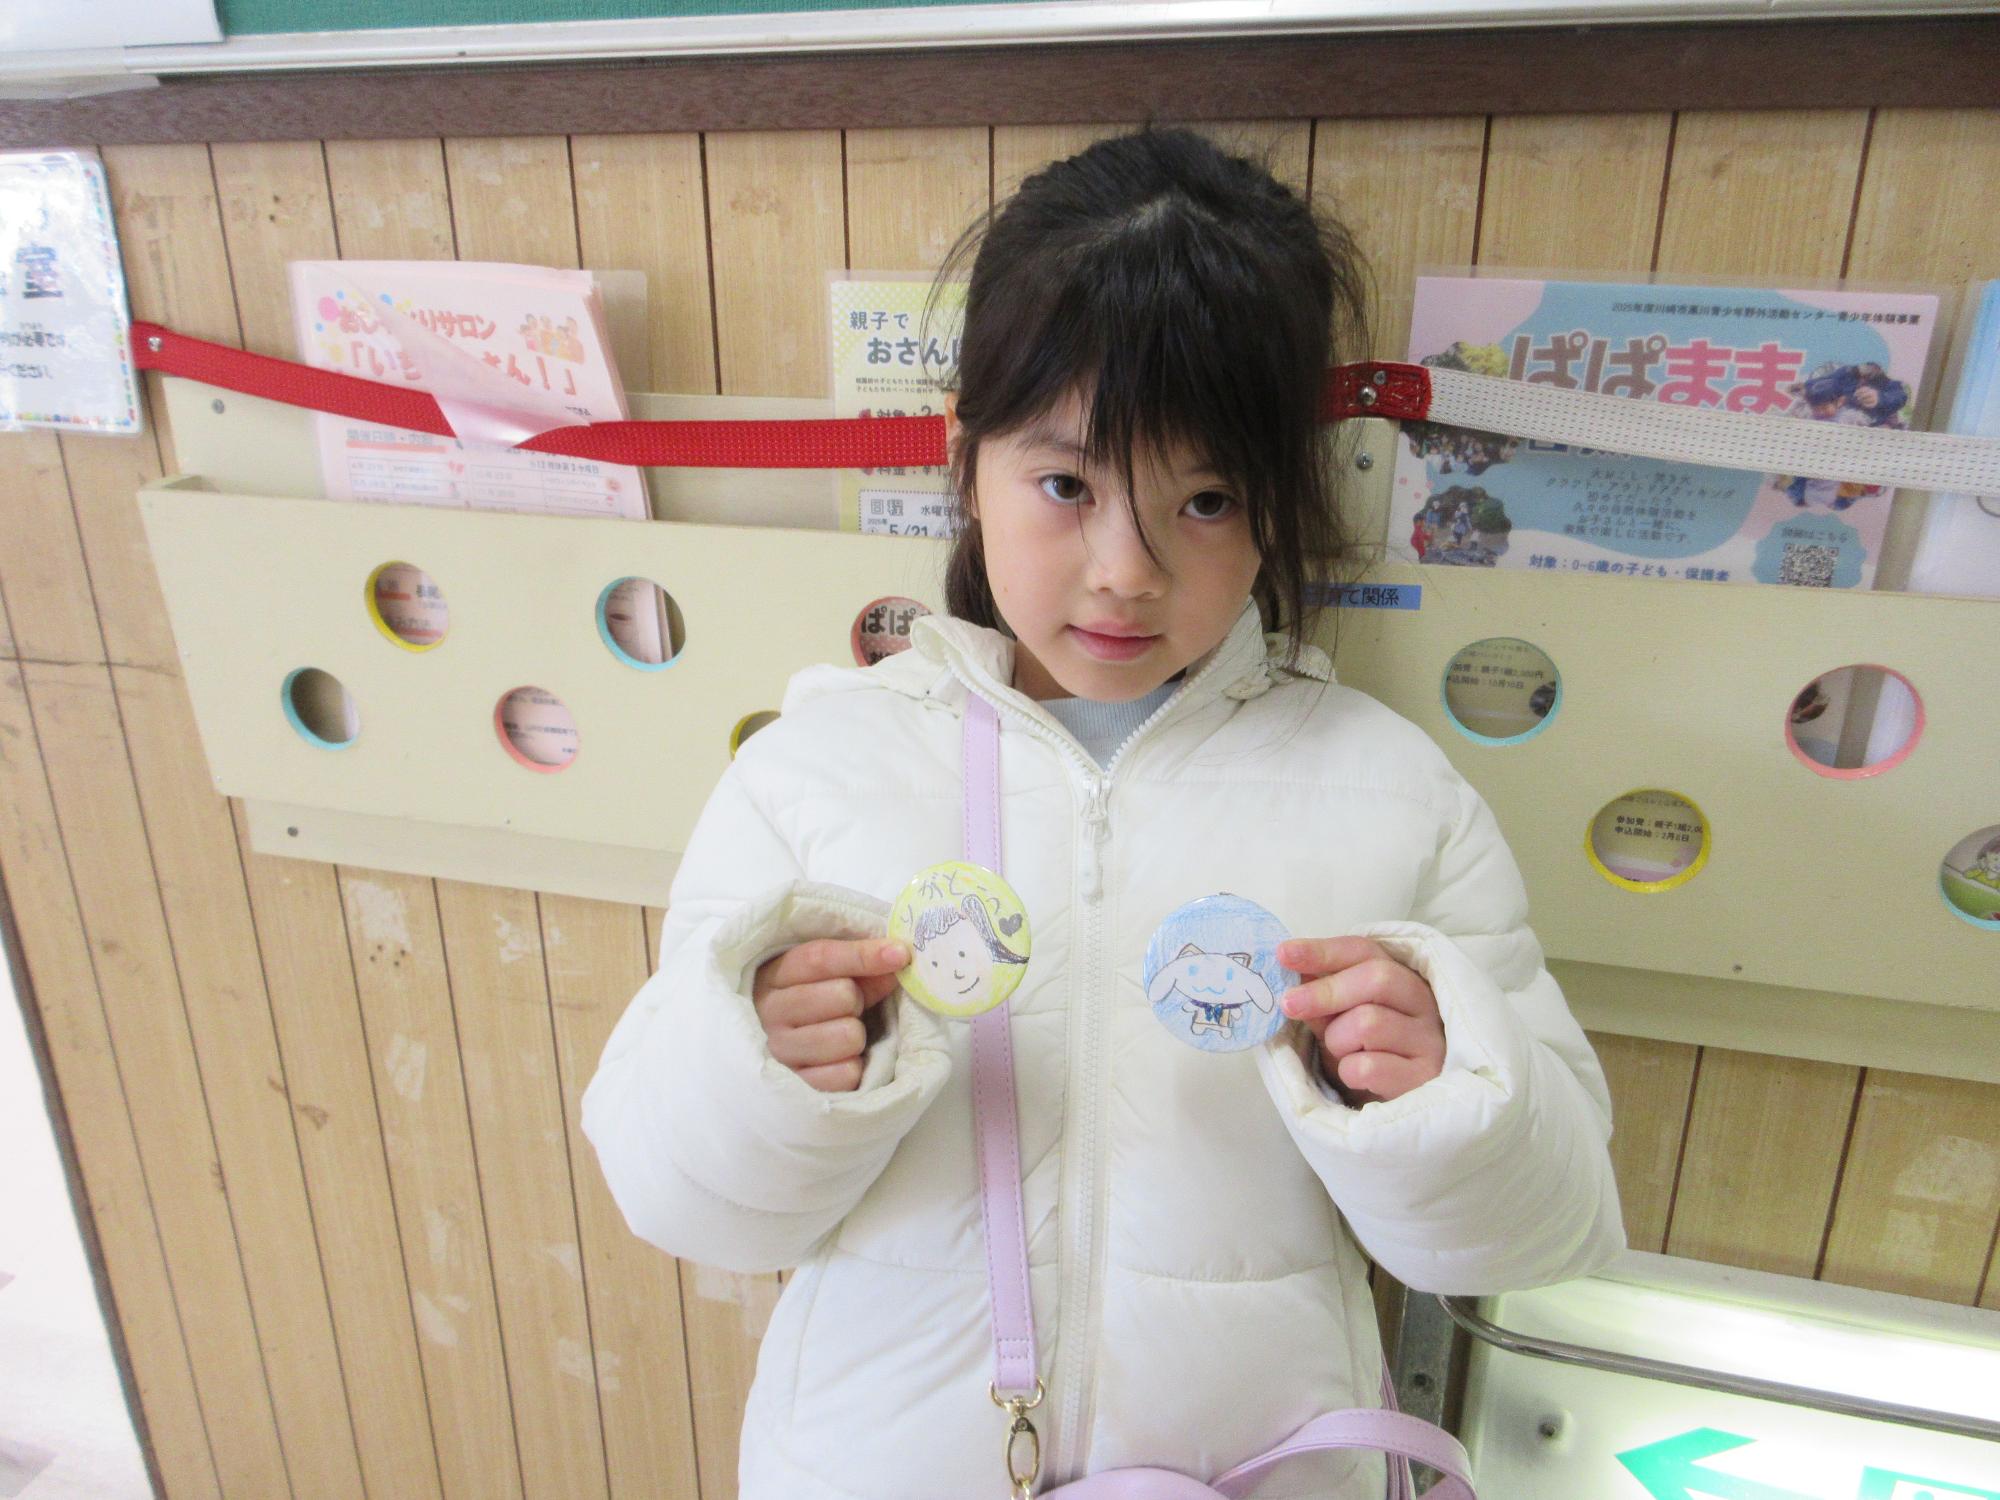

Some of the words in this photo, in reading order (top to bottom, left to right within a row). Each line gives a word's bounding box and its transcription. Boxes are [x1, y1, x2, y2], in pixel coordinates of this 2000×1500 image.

[850, 311, 909, 330] 親子で
[1509, 332, 1804, 413] ぱぱまま
